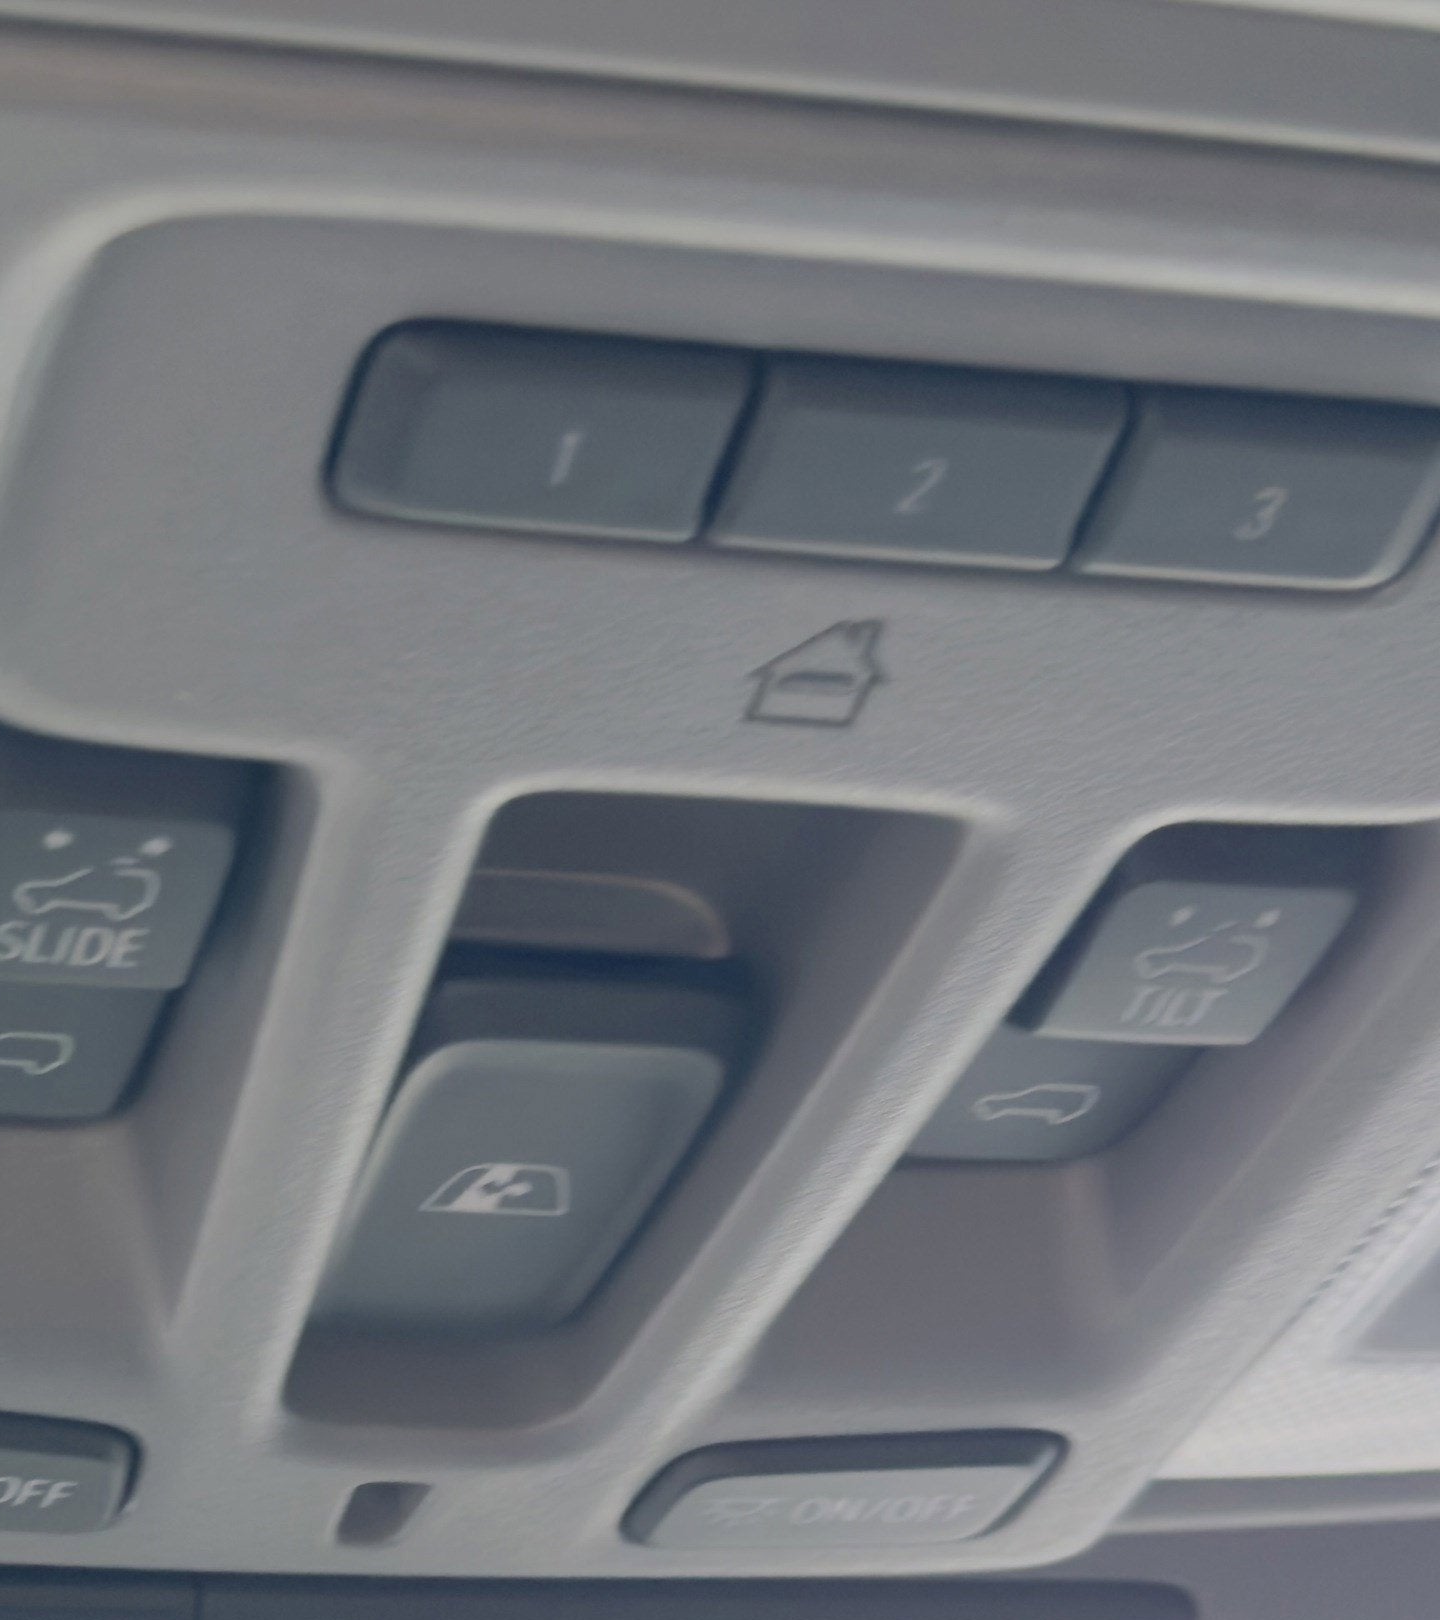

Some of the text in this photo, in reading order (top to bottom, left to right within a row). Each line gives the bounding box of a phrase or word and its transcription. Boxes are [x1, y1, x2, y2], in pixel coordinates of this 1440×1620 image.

[549, 430, 582, 486] 1
[893, 458, 947, 516] 2
[1234, 486, 1288, 541] 3
